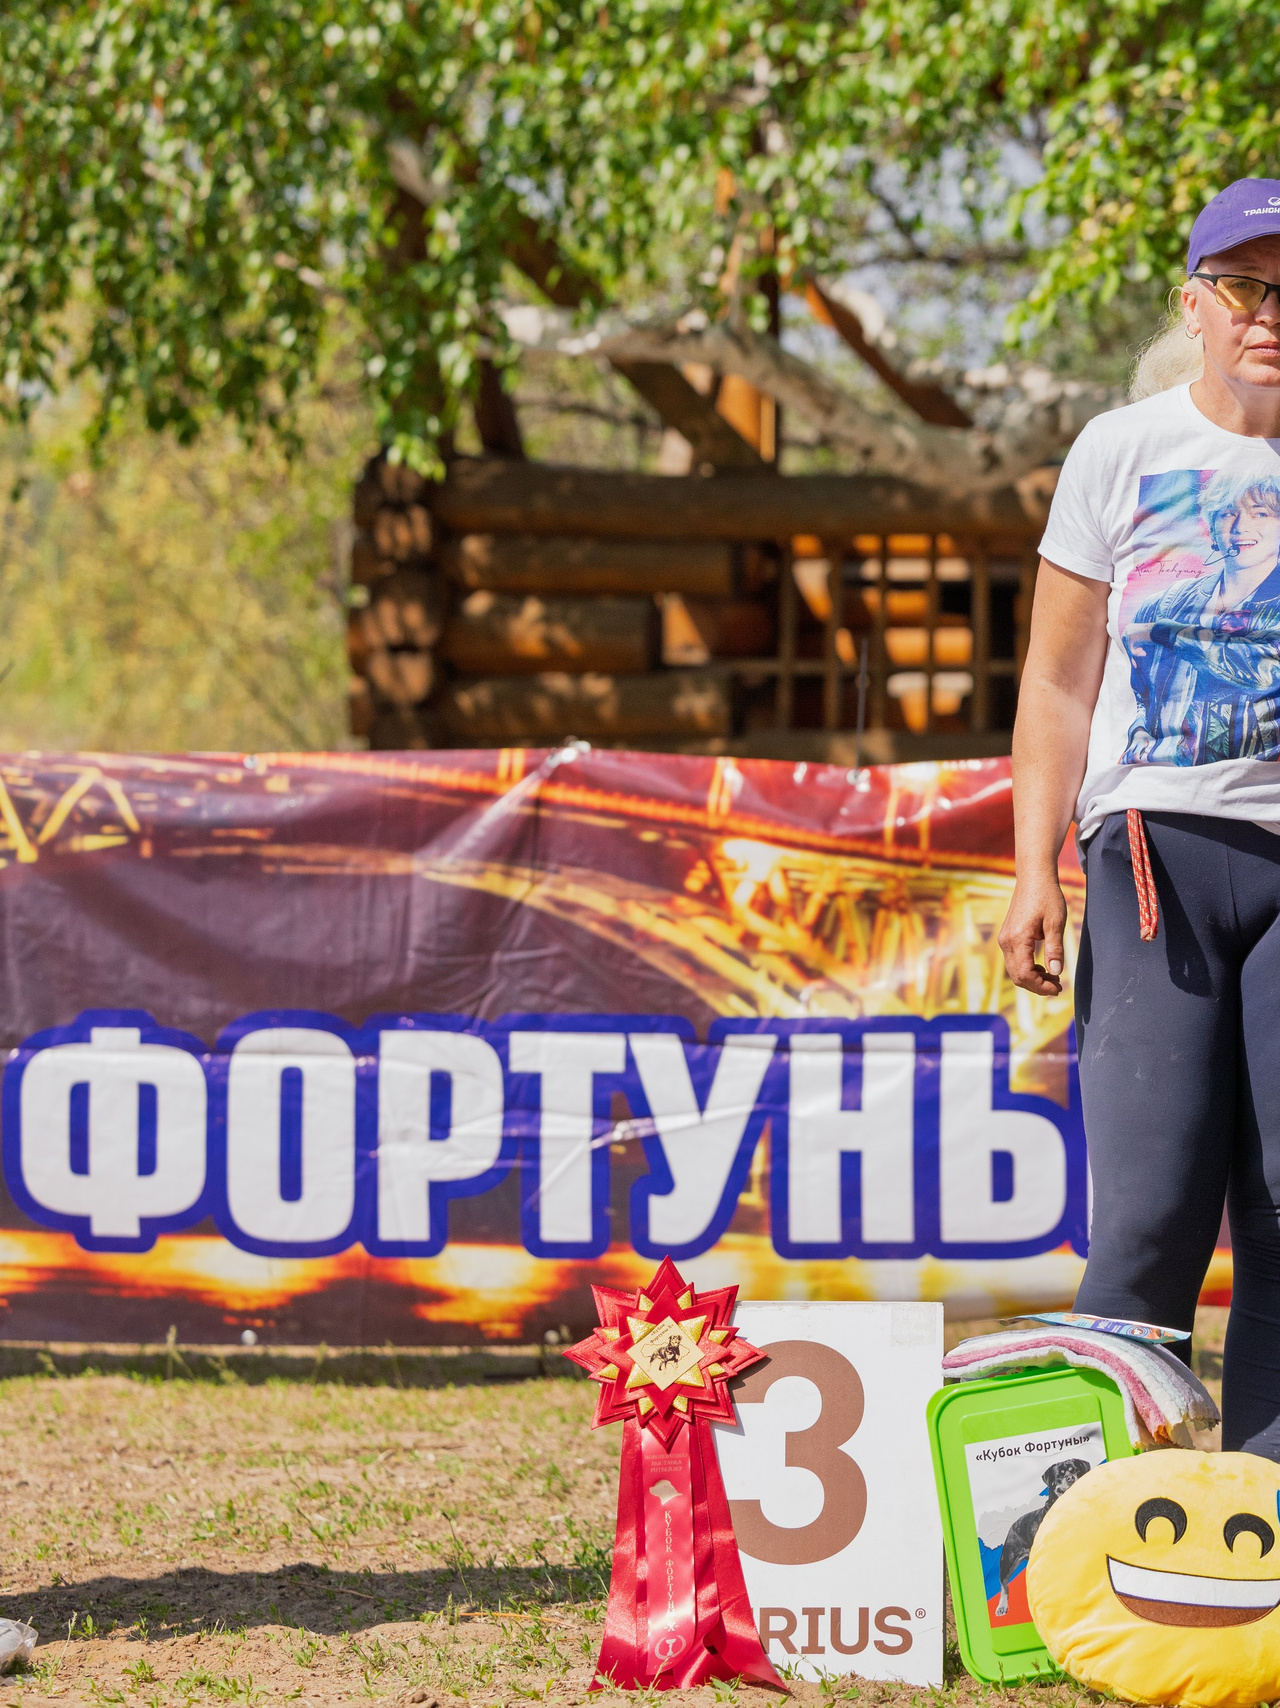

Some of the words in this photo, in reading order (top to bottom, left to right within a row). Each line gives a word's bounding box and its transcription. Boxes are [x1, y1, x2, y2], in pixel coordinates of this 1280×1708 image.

[727, 1339, 868, 1566] 3
[975, 1446, 1021, 1462] «Кубок
[1024, 1436, 1090, 1453] Фортуны»
[665, 1511, 673, 1552] КУБОК
[665, 1559, 675, 1616] ФОРТУН
